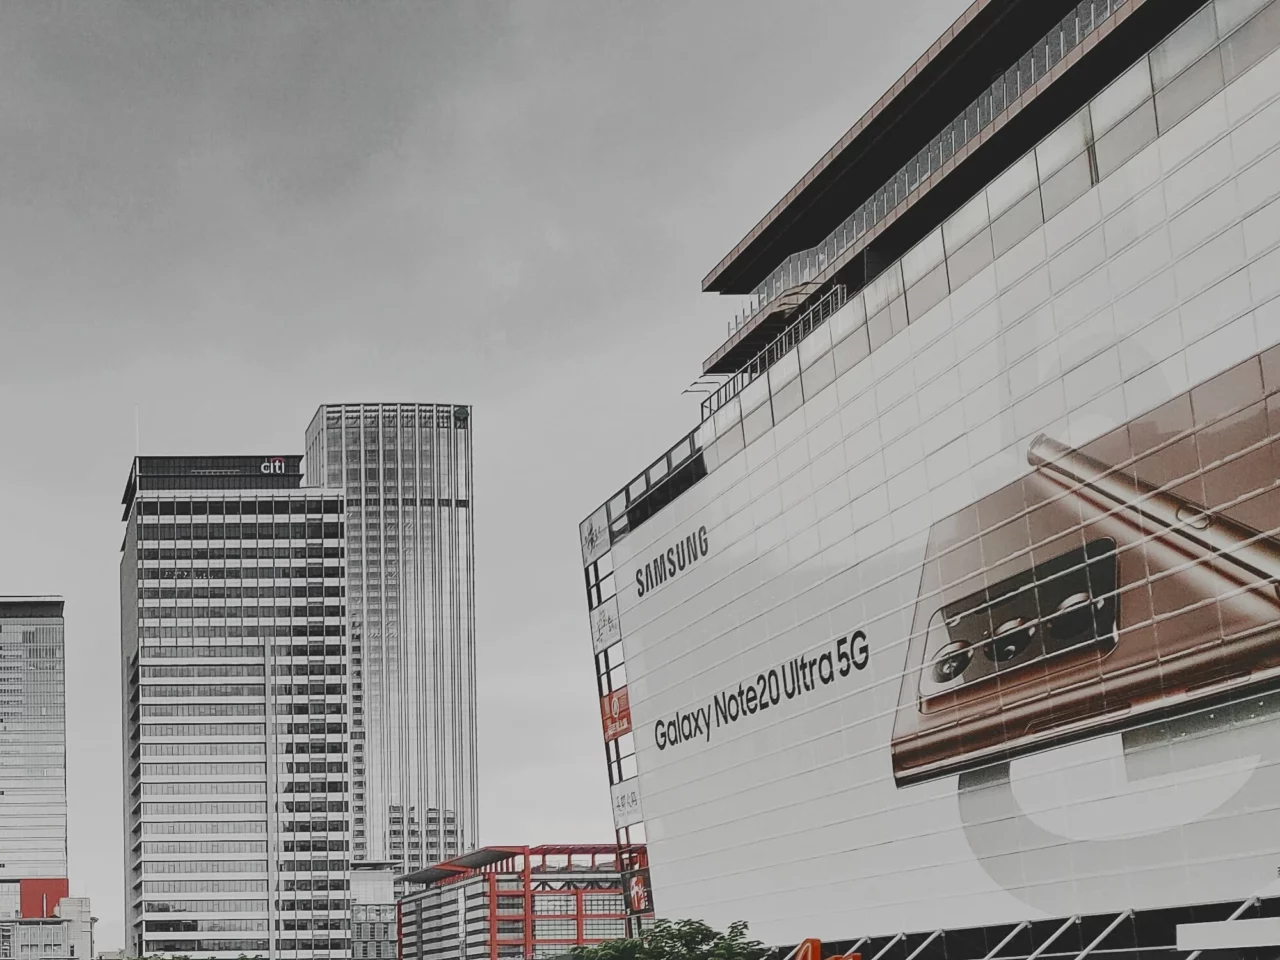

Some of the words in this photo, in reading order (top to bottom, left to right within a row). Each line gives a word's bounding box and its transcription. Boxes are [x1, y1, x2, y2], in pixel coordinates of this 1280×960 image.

[260, 458, 285, 474] citi
[635, 525, 709, 598] SAMSUNG
[654, 704, 712, 750] Galaxy
[713, 669, 781, 728] Note20
[781, 651, 835, 700] Ultra
[836, 629, 870, 678] 5G
